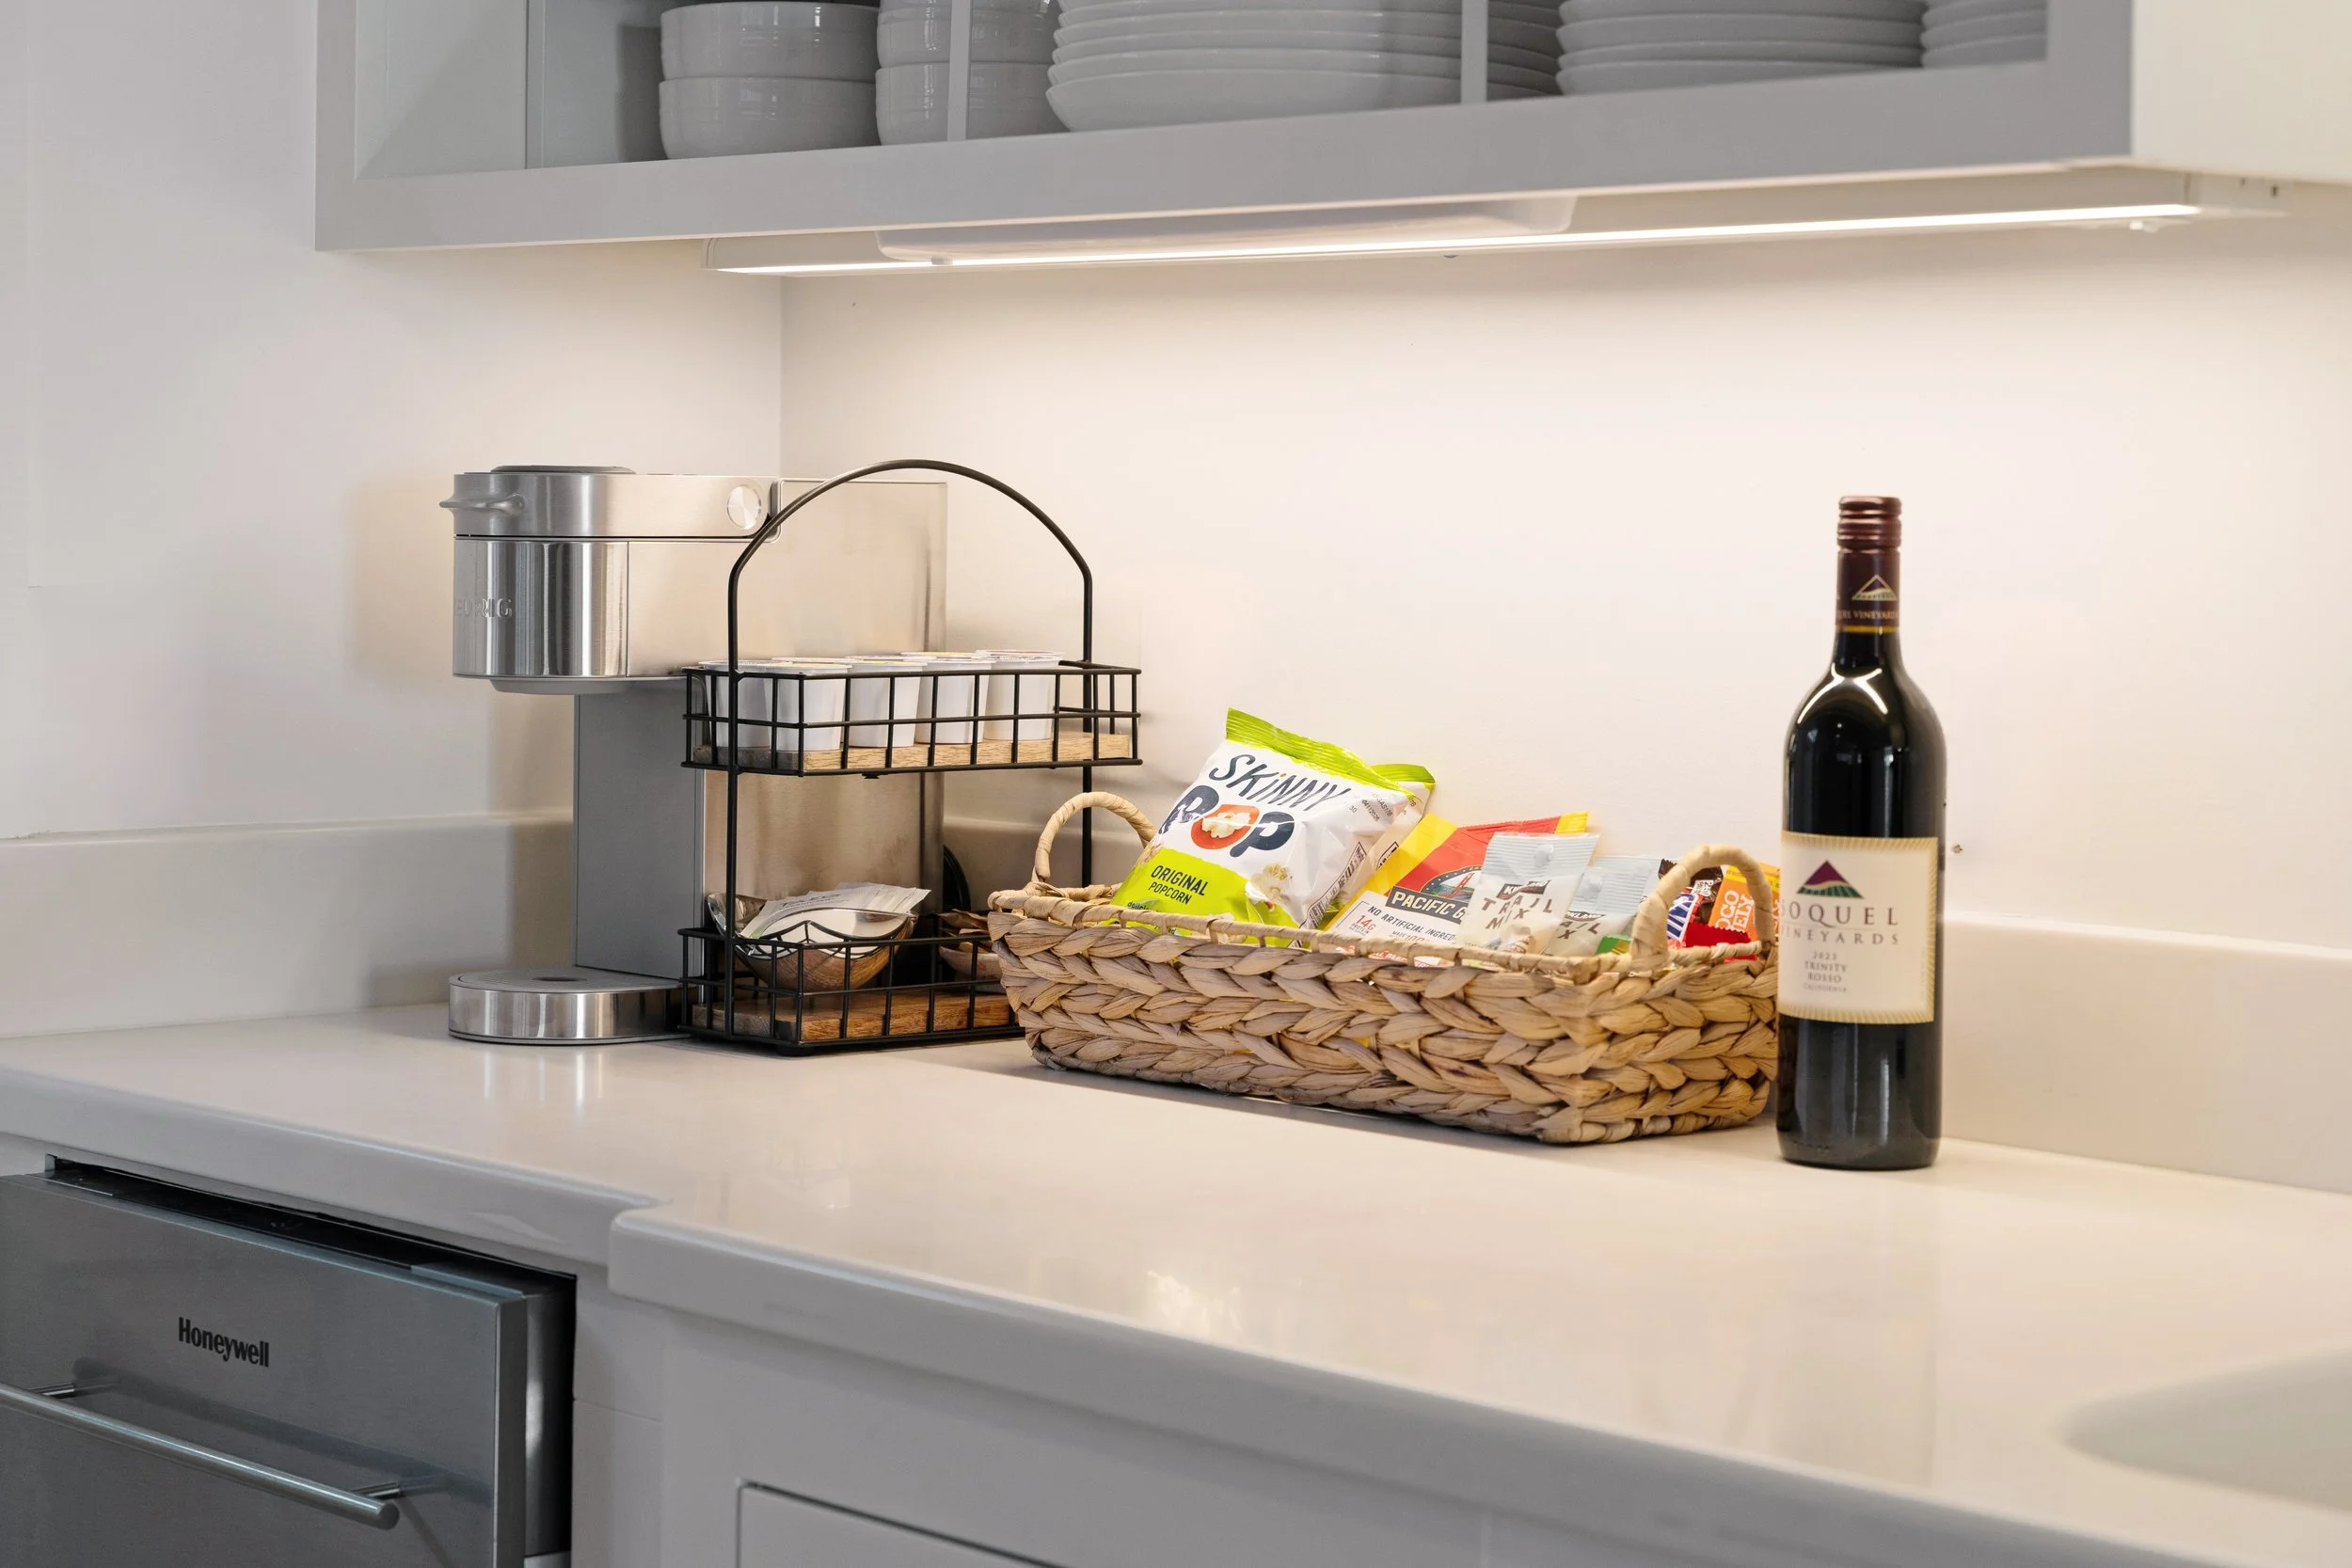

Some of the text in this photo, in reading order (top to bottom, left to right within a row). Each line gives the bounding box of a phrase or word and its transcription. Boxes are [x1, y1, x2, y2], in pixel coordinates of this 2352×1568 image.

[1158, 784, 1295, 859] POP
[1151, 864, 1209, 896] ORIGINAL
[1148, 881, 1192, 905] POPCORN
[1391, 891, 1456, 916] PACIFIC
[1481, 895, 1552, 915] TRAIL
[1367, 905, 1382, 917] NO
[1380, 912, 1427, 934] ARTIFICIAL
[1485, 908, 1531, 930] MIX
[1804, 960, 1850, 973] TRINITY
[1807, 972, 1842, 984] ROSSO
[178, 1316, 270, 1369] Honeywell
